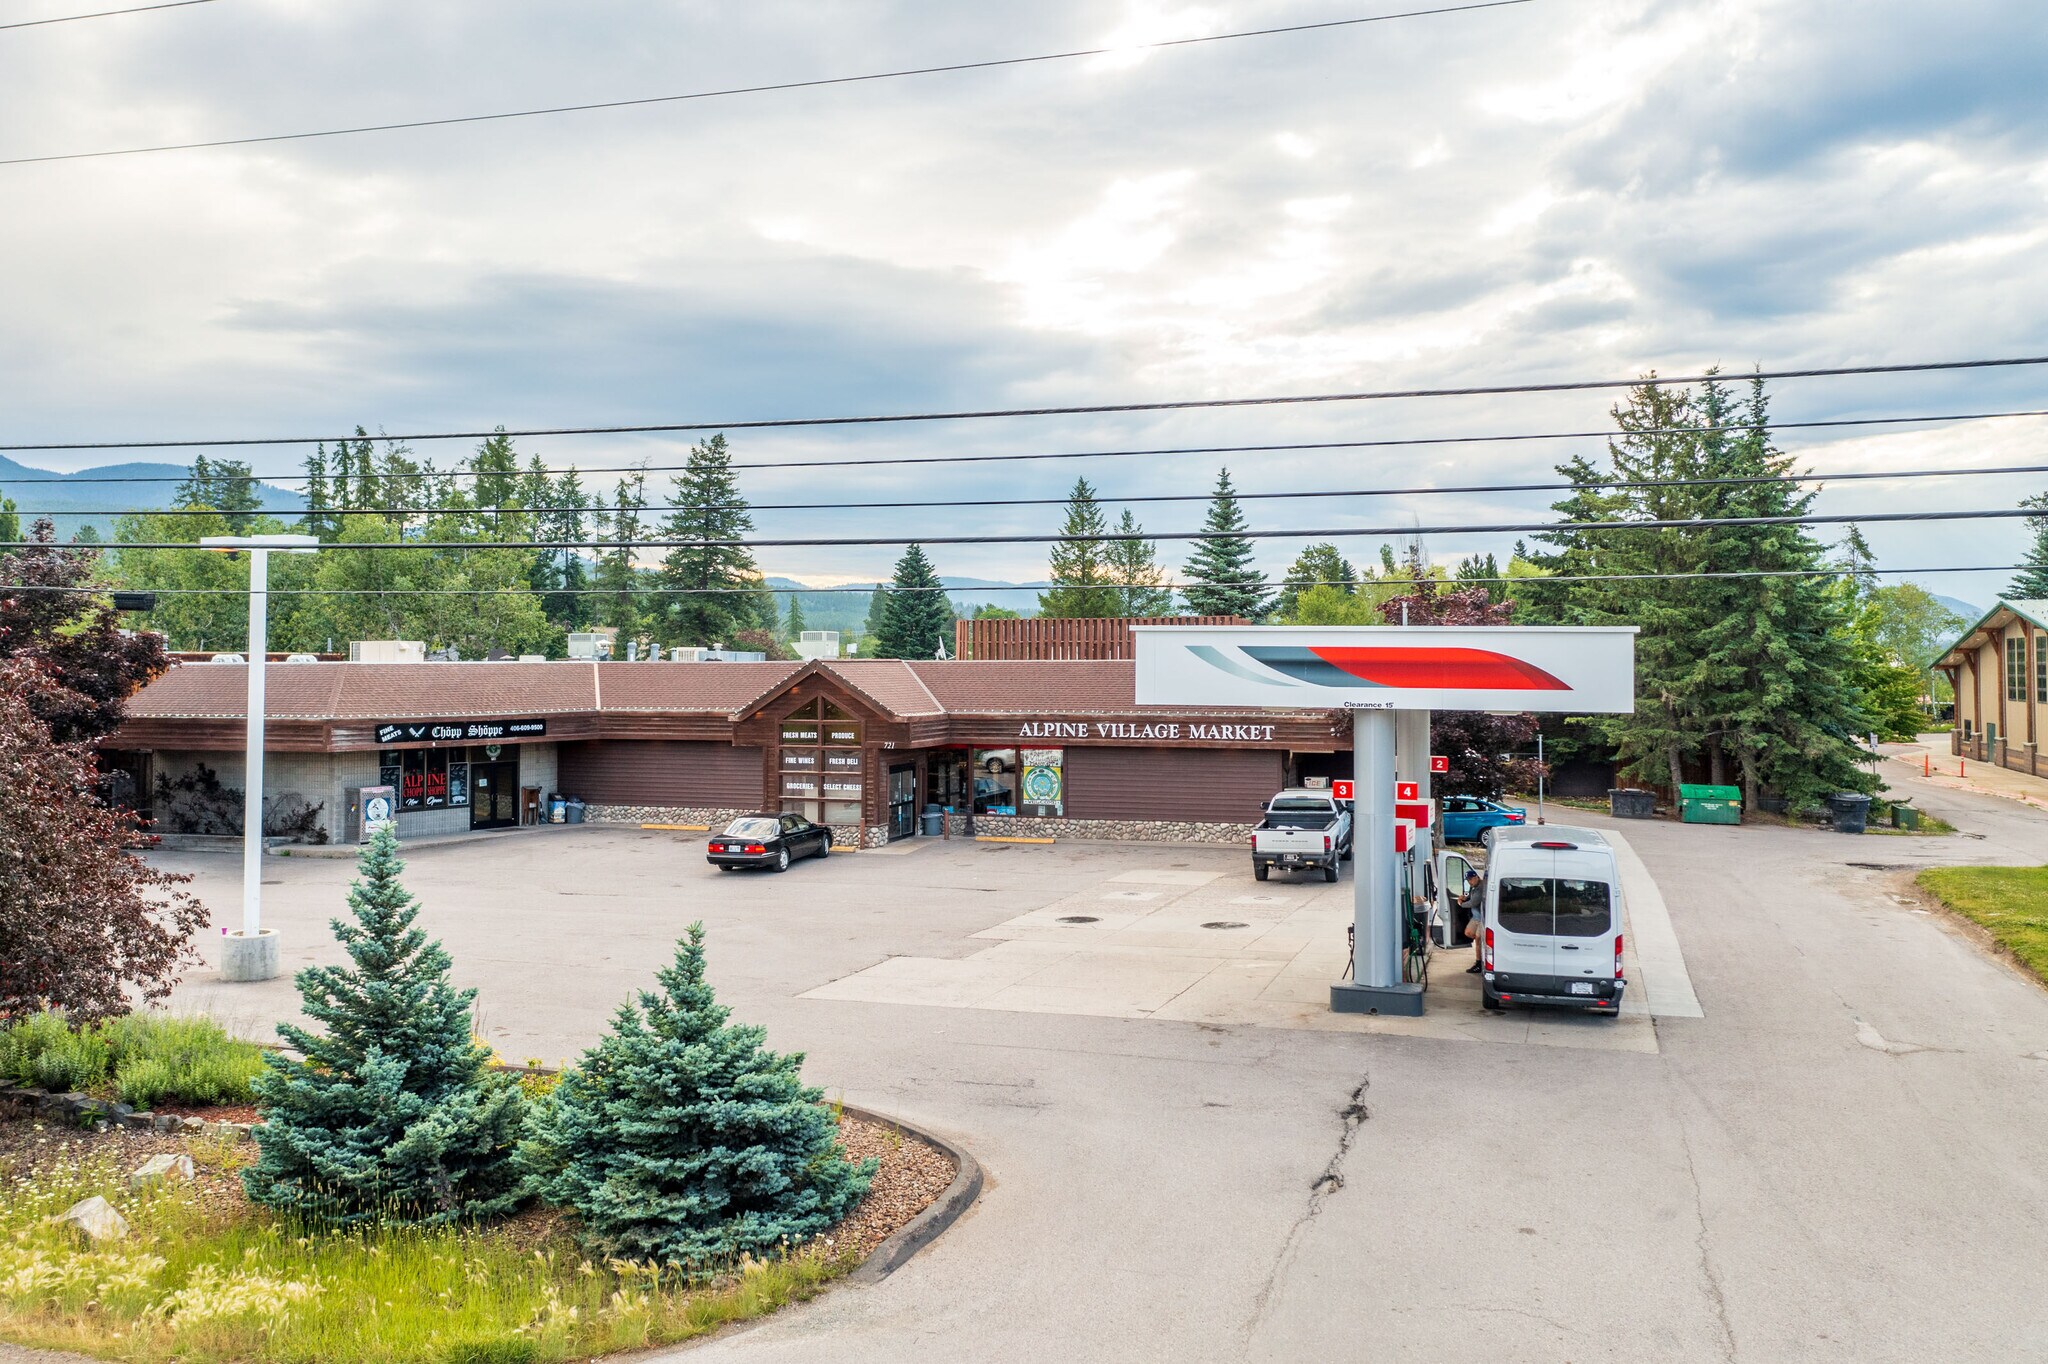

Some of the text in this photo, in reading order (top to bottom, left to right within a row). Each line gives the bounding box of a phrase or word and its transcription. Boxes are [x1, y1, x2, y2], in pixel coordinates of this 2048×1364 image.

[379, 724, 394, 736] FINE
[432, 724, 503, 739] Chöpp Shöppe
[1019, 722, 1275, 740] ALPINE VILLAGE MARKET
[381, 729, 402, 743] MEATS
[884, 741, 895, 749] 721
[1436, 760, 1443, 769] 2
[786, 782, 814, 790] GROCERIES
[823, 783, 843, 791] SELECT
[1339, 785, 1347, 795] 3
[1403, 786, 1411, 797] 4
